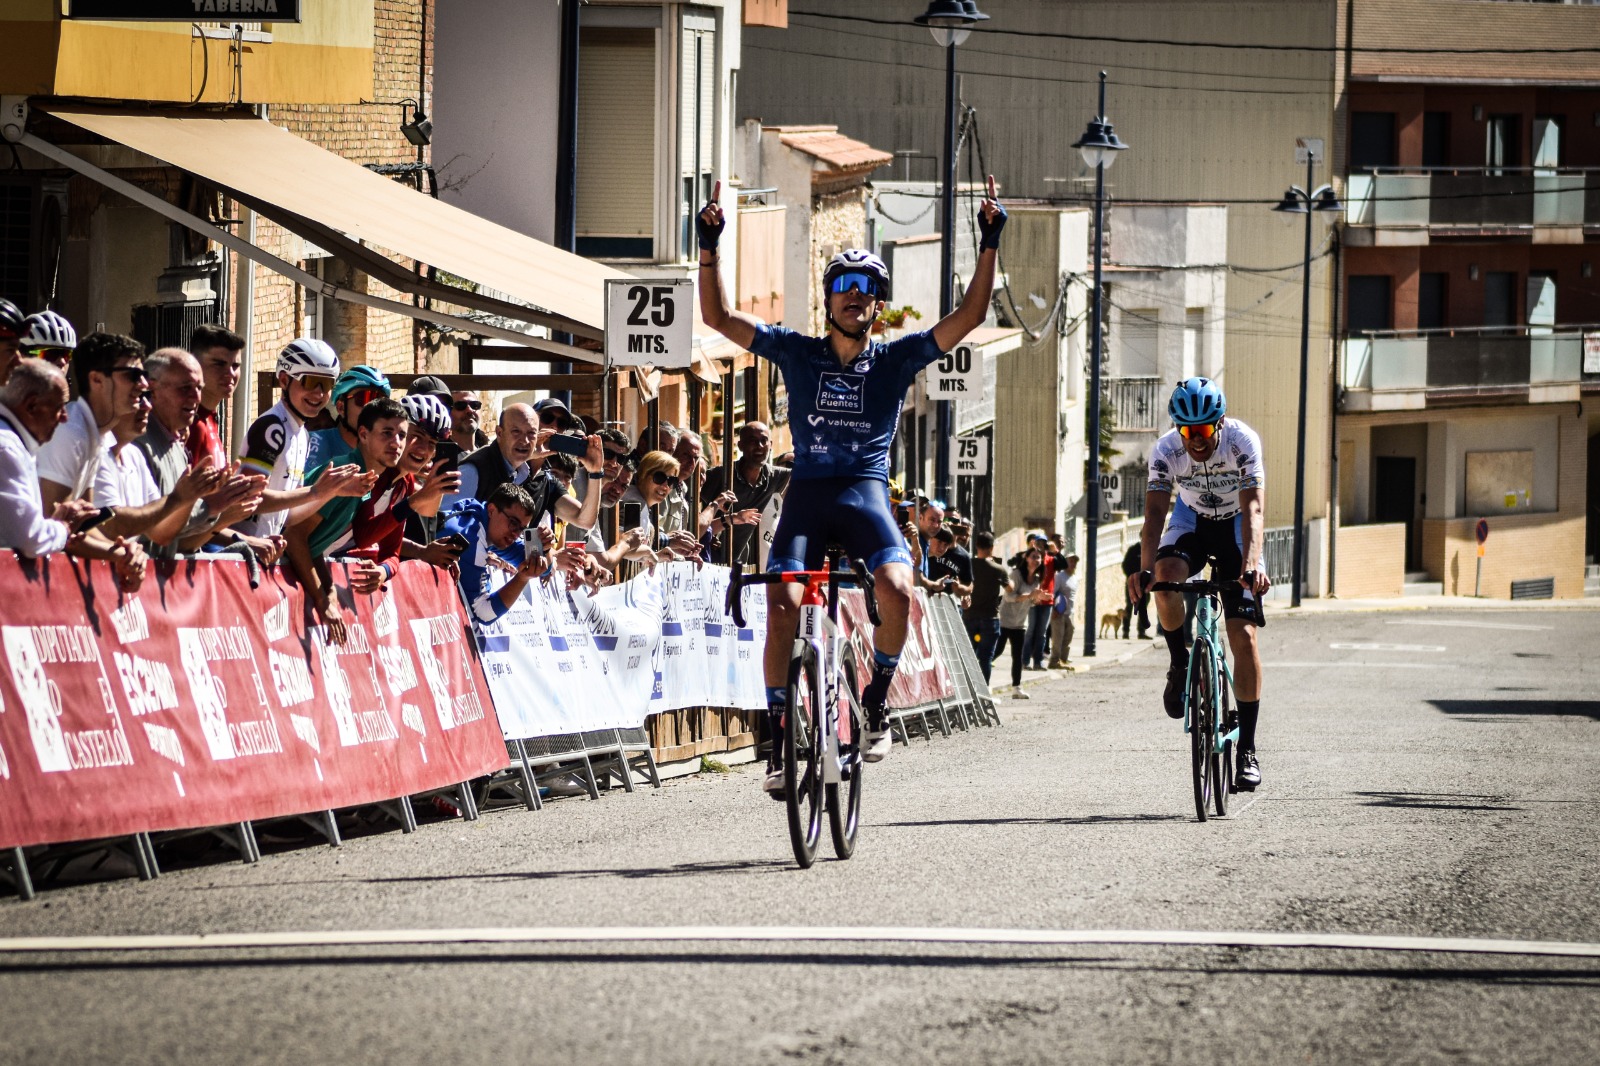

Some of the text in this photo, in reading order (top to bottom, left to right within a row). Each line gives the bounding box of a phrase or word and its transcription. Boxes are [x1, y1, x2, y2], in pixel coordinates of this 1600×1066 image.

[192, 0, 278, 13] TABERNA
[627, 286, 674, 327] 25
[628, 334, 668, 354] MTS.
[938, 346, 971, 374] 50
[940, 379, 967, 392] MTS.
[821, 392, 858, 401] Ricardo
[820, 399, 858, 409] Fuentes
[828, 419, 872, 429] valverde
[957, 440, 977, 458] 75
[958, 461, 976, 470] MTS.
[1100, 475, 1118, 490] 00
[64, 718, 131, 769] CASTELLÓ
